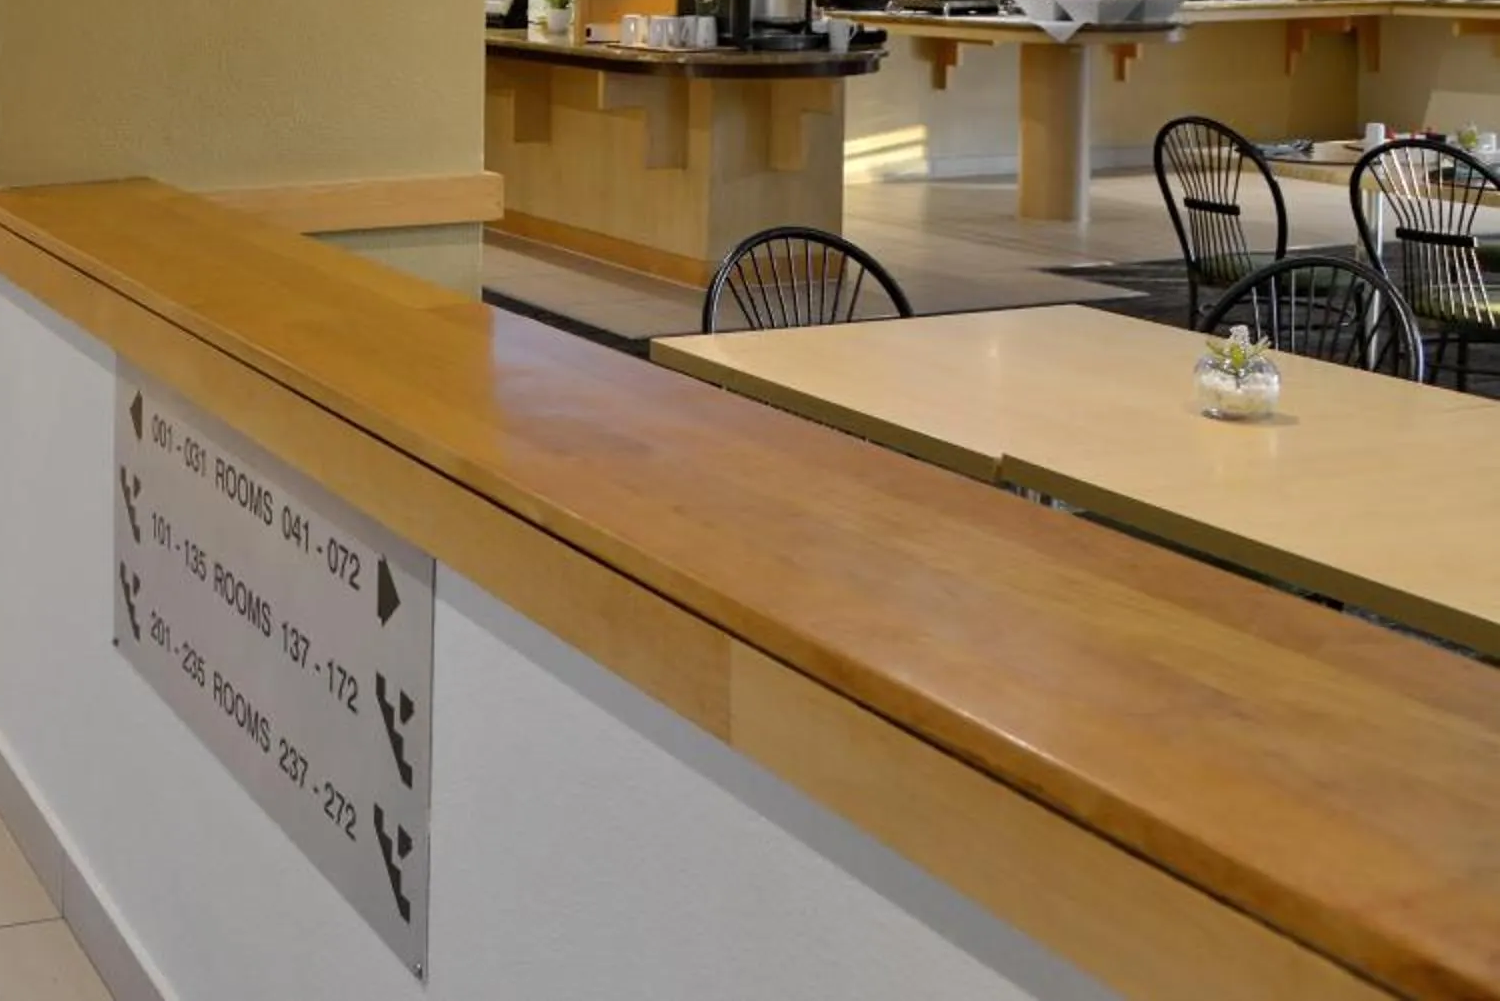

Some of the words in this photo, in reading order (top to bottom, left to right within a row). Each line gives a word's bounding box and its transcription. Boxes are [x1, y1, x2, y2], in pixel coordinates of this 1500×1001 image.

[215, 458, 274, 526] ROOMS
[213, 562, 272, 637] ROOMS
[213, 671, 271, 753] ROOMS
